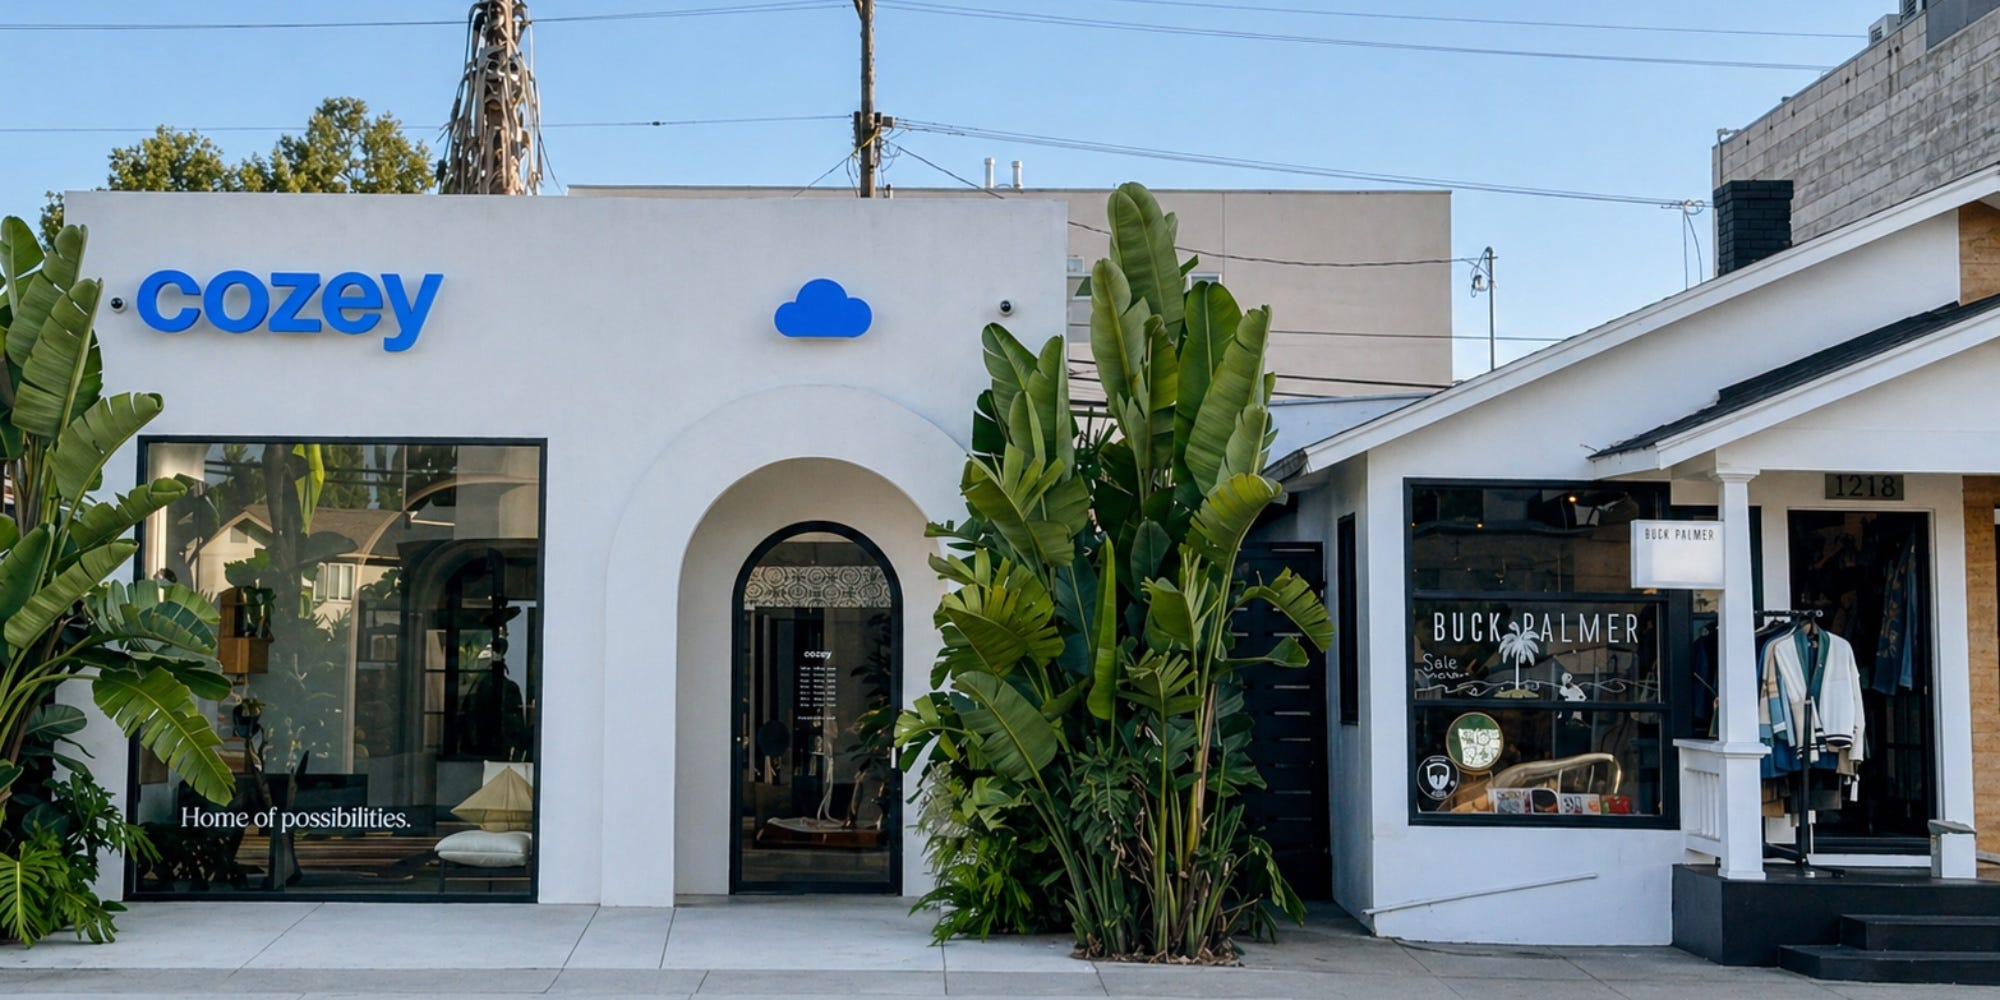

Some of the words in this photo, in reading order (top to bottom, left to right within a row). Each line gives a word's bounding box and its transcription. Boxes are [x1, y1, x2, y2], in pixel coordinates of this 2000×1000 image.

[136, 269, 444, 352] cozey
[1835, 475, 1896, 498] 1218
[1645, 528, 1669, 540] BUCK
[1675, 529, 1714, 541] PALMER
[1434, 612, 1501, 642] BUCK
[1523, 612, 1639, 644] PALMER
[1423, 653, 1458, 671] Sale
[181, 807, 249, 828] Home
[254, 807, 277, 828] of
[281, 807, 412, 833] possibilities.
